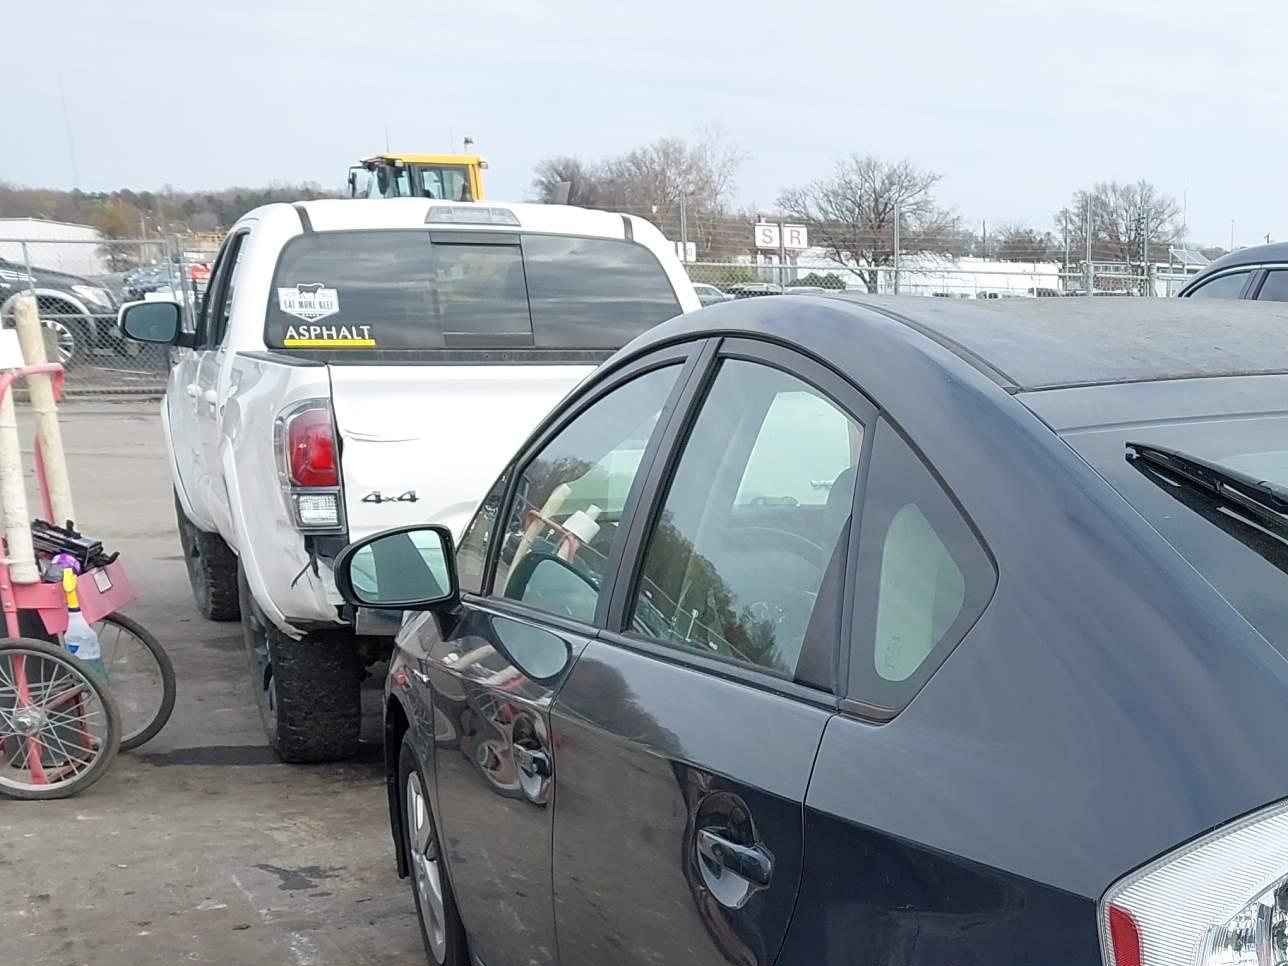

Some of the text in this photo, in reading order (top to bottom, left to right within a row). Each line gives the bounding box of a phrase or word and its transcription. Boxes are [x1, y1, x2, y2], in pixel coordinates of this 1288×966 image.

[761, 228, 774, 245] S
[790, 229, 801, 246] R
[286, 325, 371, 340] ASPHALT
